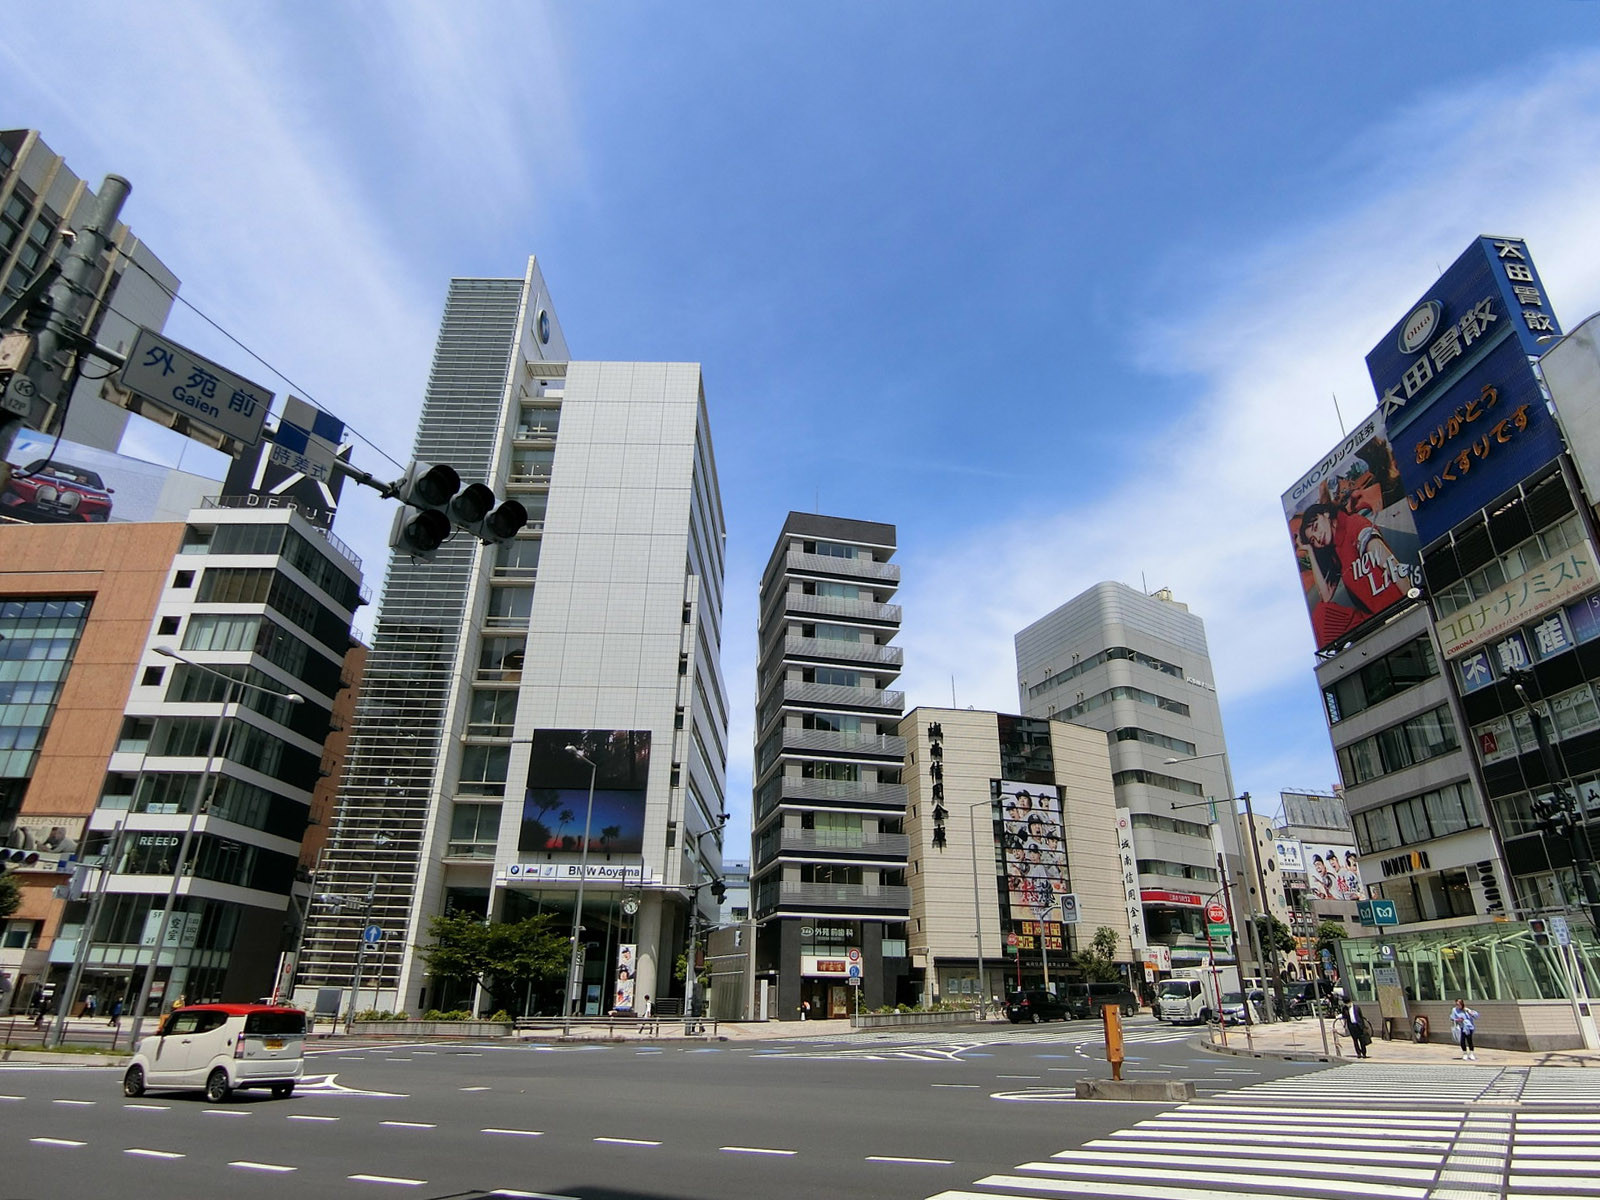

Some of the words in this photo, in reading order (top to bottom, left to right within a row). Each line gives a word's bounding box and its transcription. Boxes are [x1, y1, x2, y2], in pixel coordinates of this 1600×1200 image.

[1493, 241, 1554, 331] 太田胃散
[1378, 295, 1498, 424] 太田胃散
[1406, 314, 1432, 341] Ohta
[143, 346, 259, 417] 外苑前
[172, 386, 219, 418] Gaien
[1407, 403, 1530, 510] いいくすりです
[1414, 383, 1497, 464] ありがとう
[272, 446, 327, 481] 時差式
[1292, 421, 1375, 500] GMOクリック証券
[1447, 639, 1474, 655] CORONA
[1462, 617, 1567, 685] 不動産
[598, 867, 640, 878] Aoyama
[1121, 839, 1140, 938] 城南信用金庫
